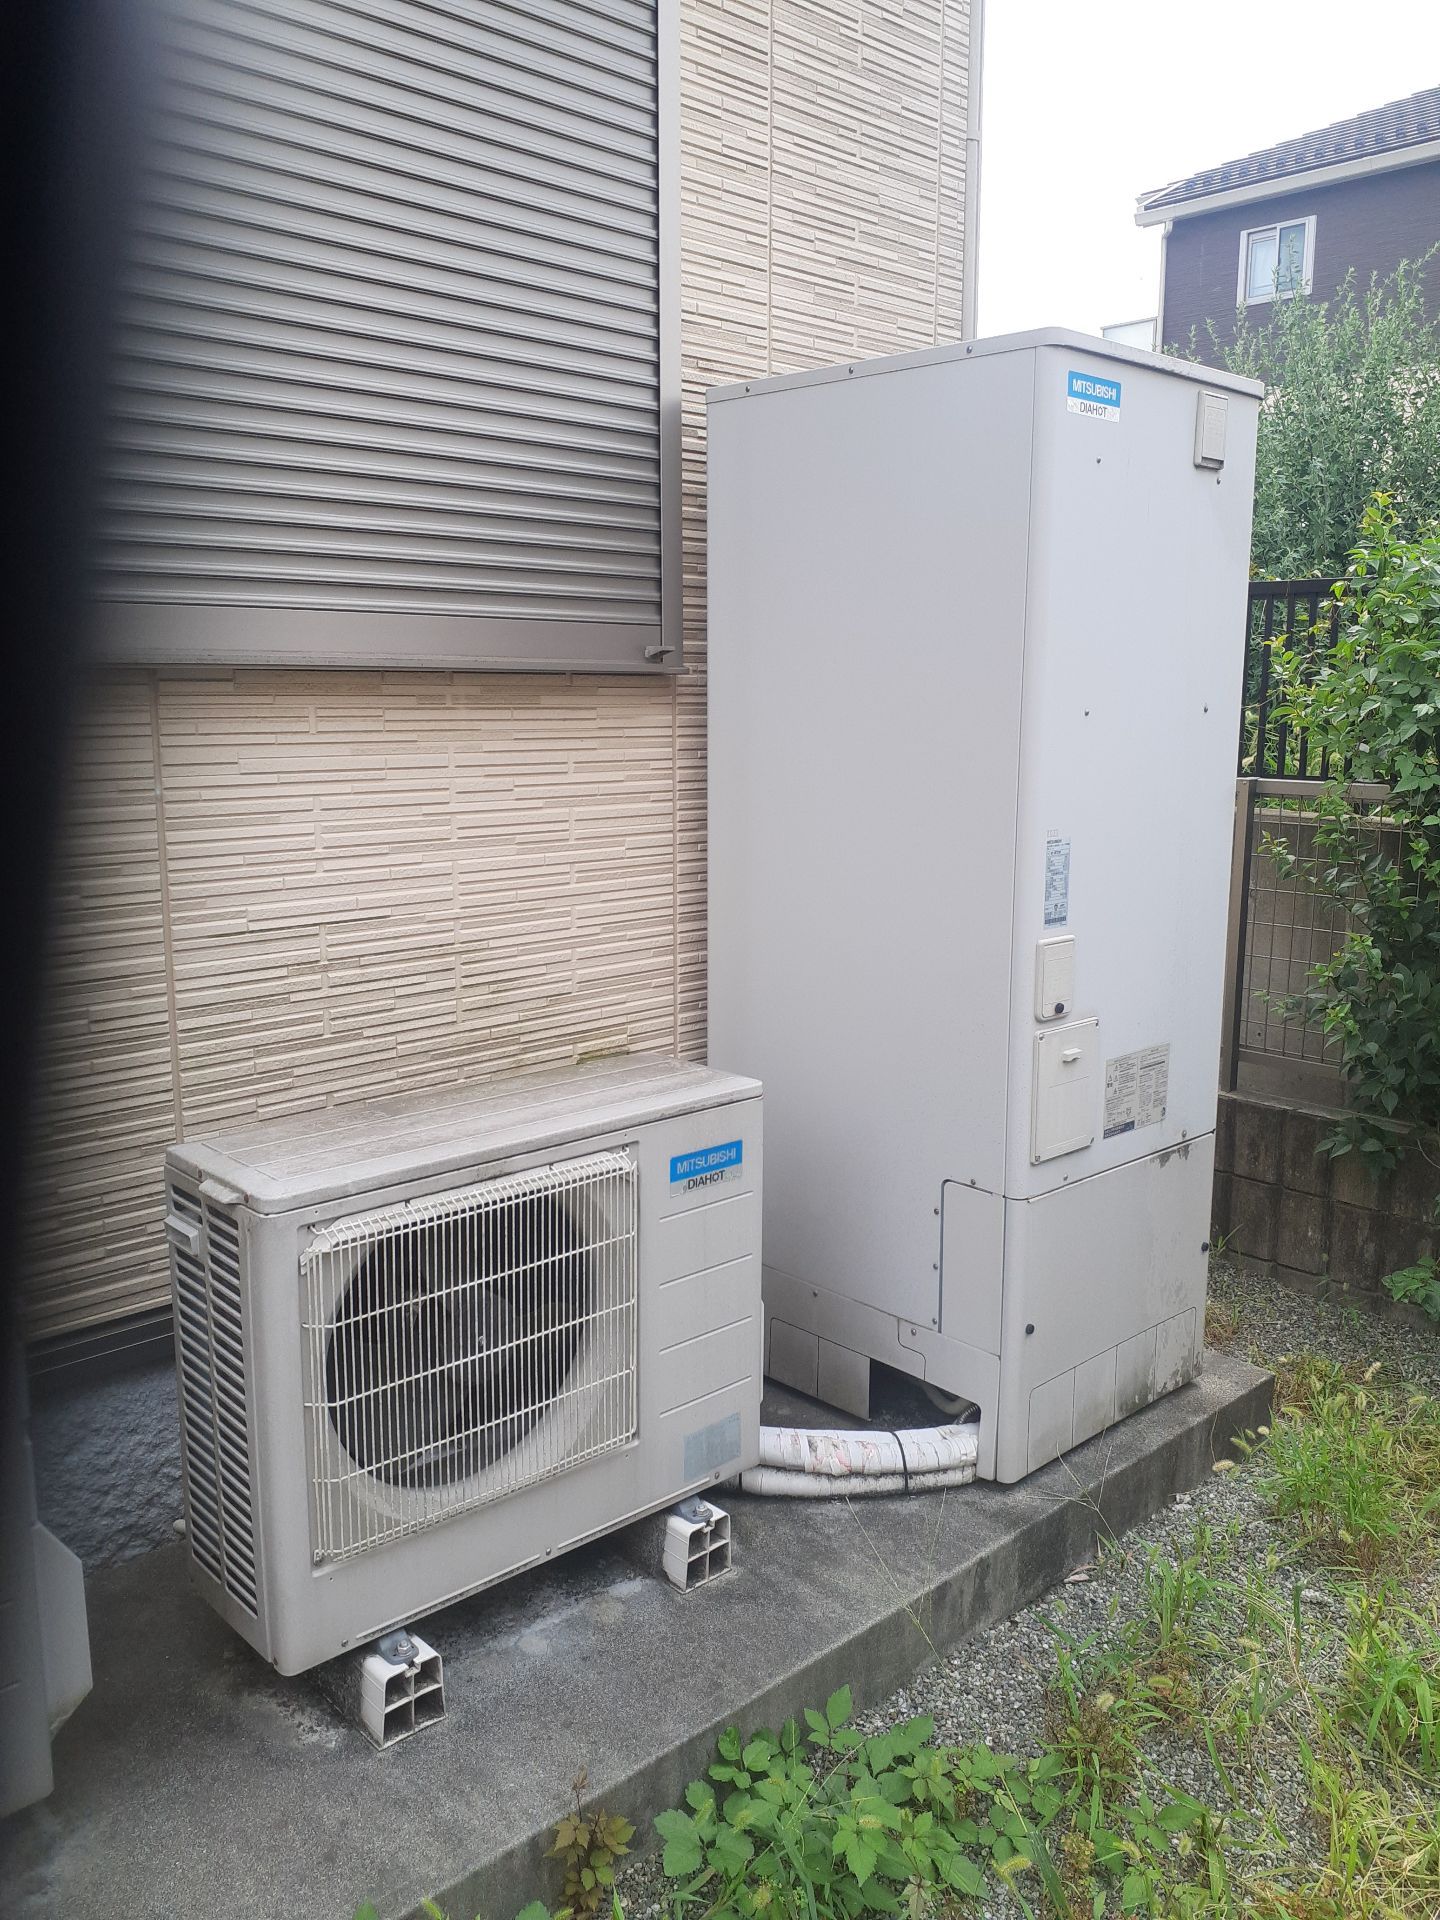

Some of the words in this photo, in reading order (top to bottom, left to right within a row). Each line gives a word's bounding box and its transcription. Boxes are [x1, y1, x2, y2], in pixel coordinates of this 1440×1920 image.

[1072, 379, 1117, 401] MITSUBISHI
[1079, 401, 1108, 418] DIAHOT
[677, 1147, 736, 1174] MITSUBISHI
[687, 1169, 725, 1190] DIAHOT
